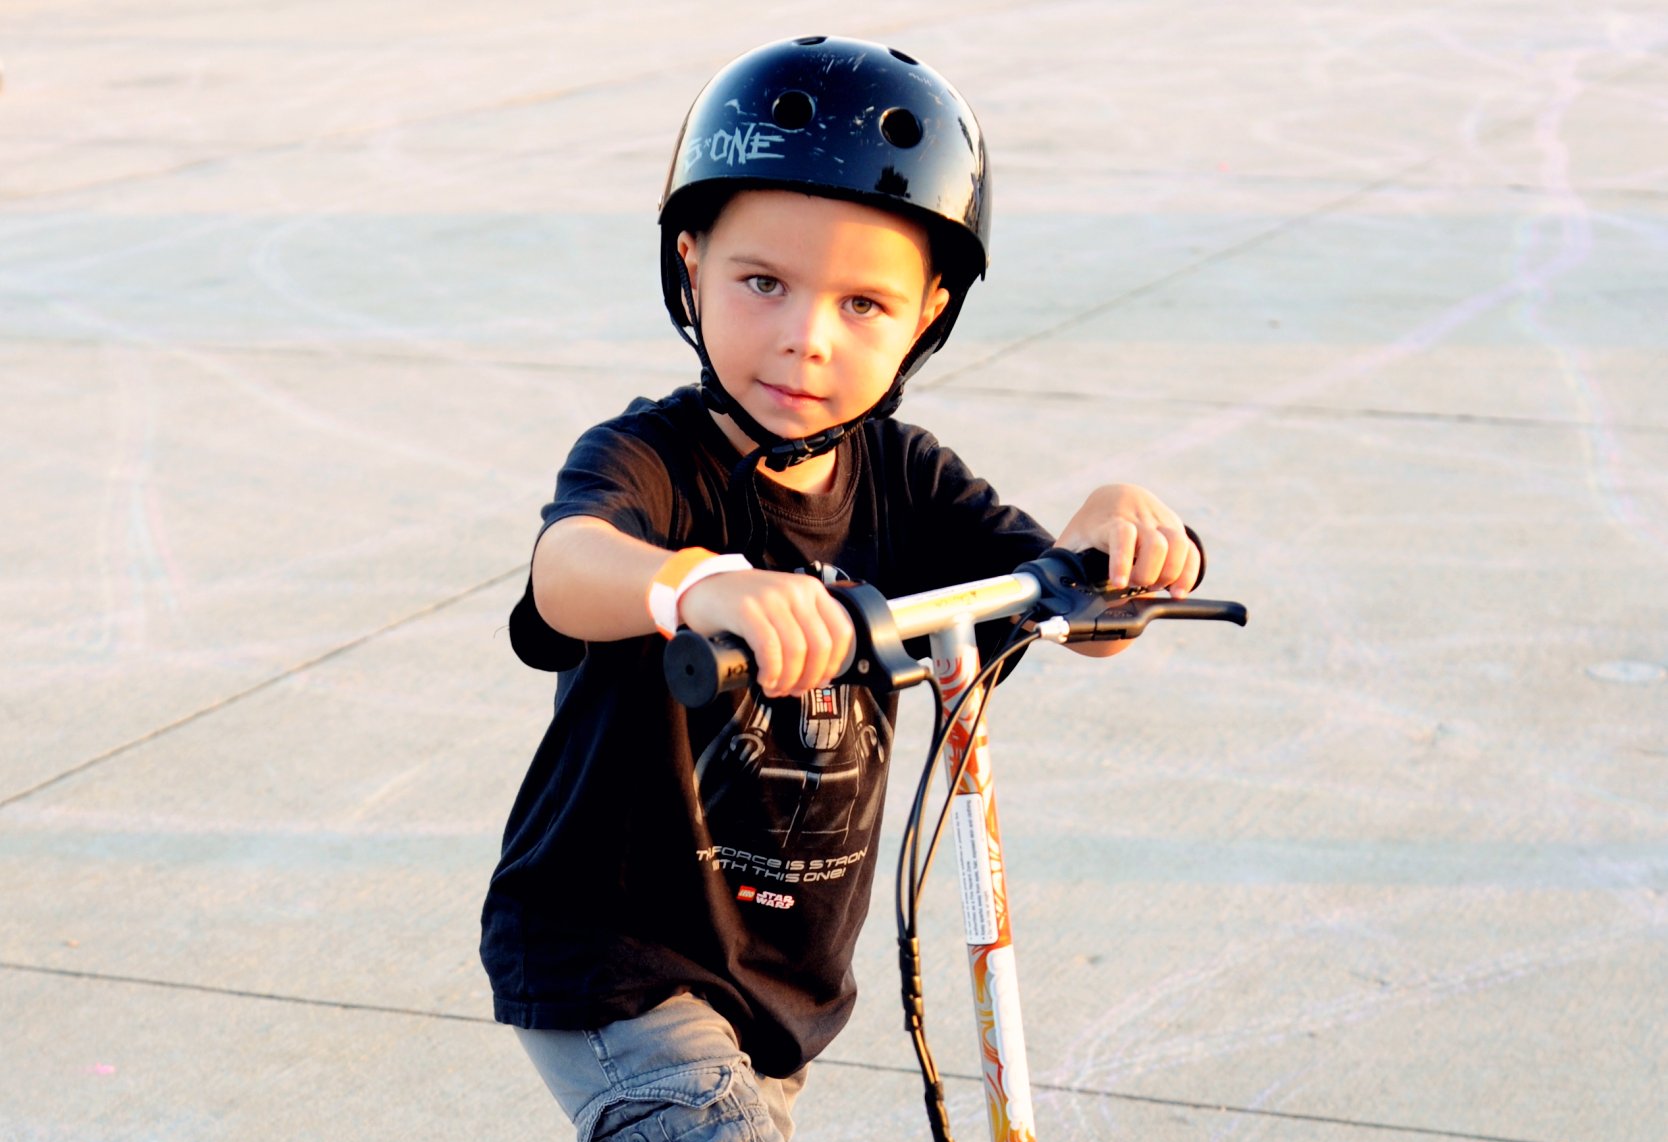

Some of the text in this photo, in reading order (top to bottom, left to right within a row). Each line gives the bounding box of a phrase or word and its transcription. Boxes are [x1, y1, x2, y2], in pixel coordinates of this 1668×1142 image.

[785, 860, 805, 871] IS
[809, 846, 867, 870] STRON
[752, 866, 800, 883] THIS
[756, 898, 795, 909] WARS
[757, 891, 792, 902] STAR
